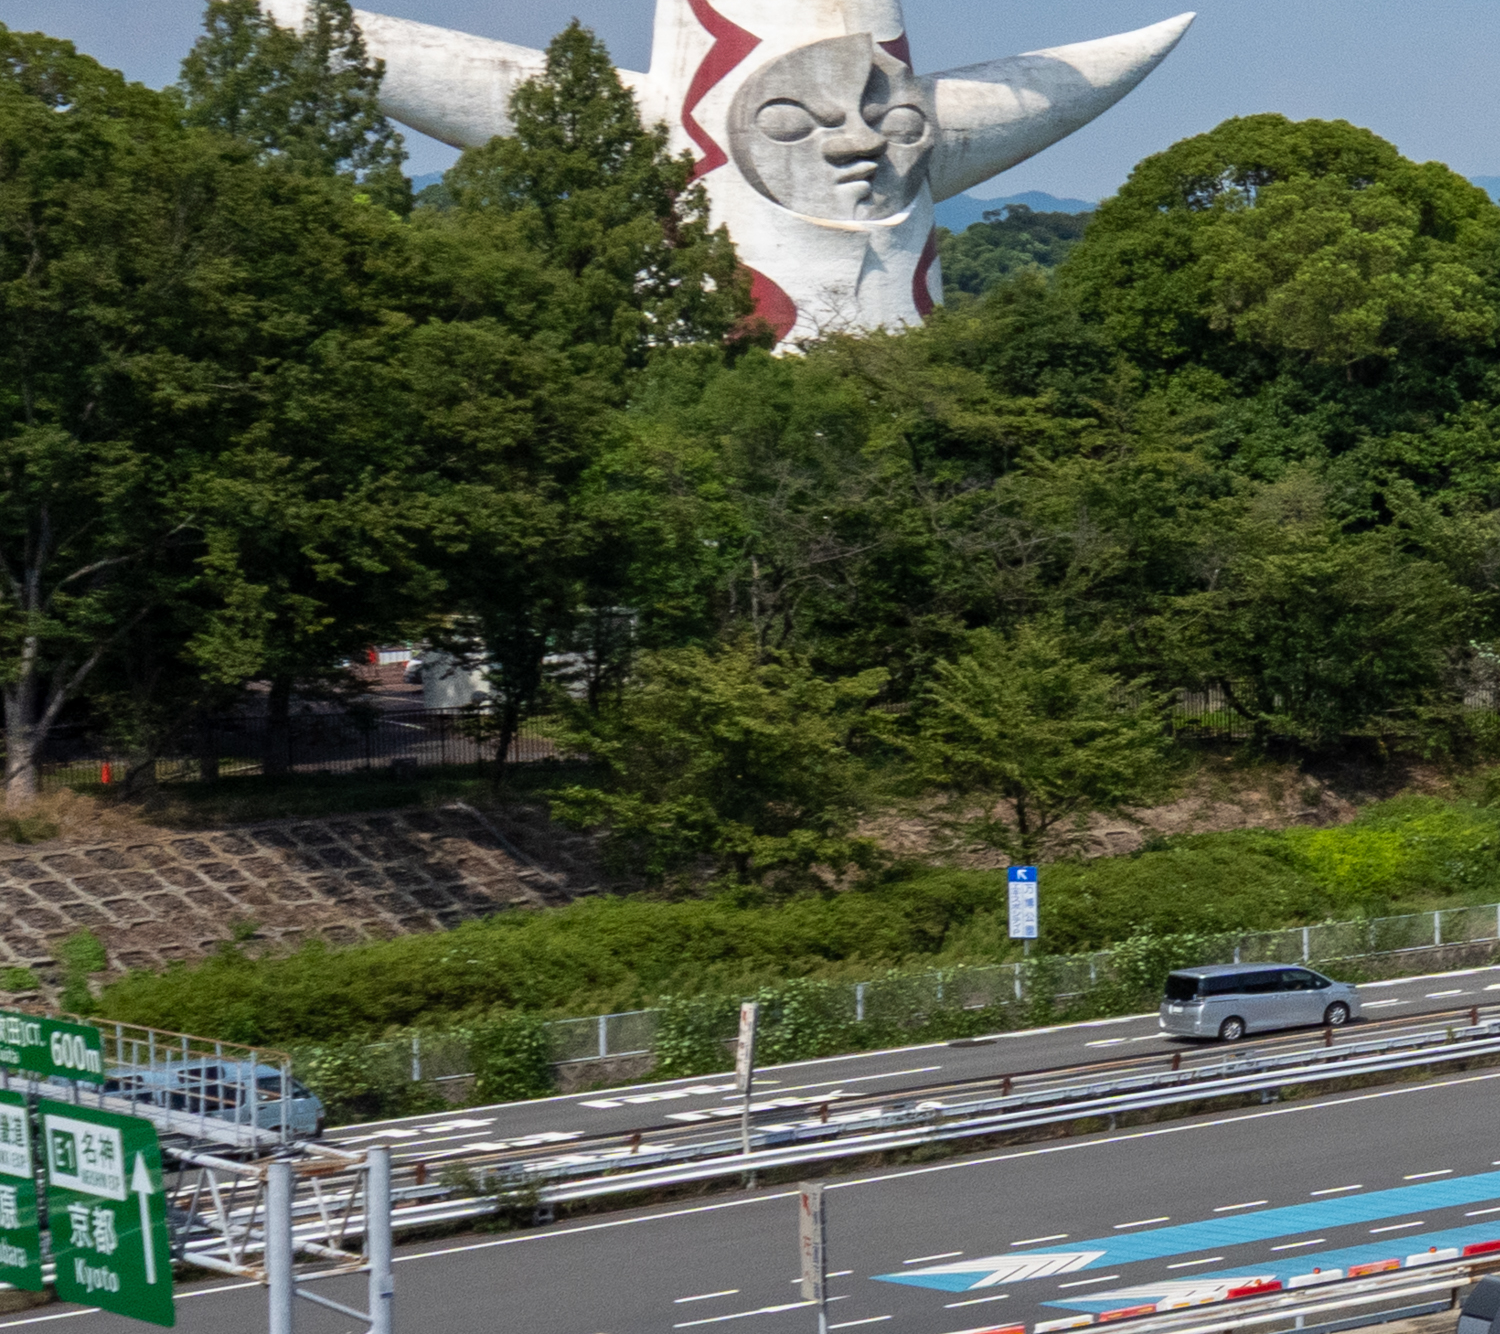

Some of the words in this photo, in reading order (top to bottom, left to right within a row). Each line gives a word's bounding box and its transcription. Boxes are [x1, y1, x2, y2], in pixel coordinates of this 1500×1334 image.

[1024, 883, 1034, 935] 万博公園
[51, 1030, 100, 1073] 600m
[54, 1136, 74, 1170] E1
[82, 1130, 114, 1170] 名神
[67, 1202, 118, 1255] 京都
[74, 1257, 120, 1293] Kyoto
